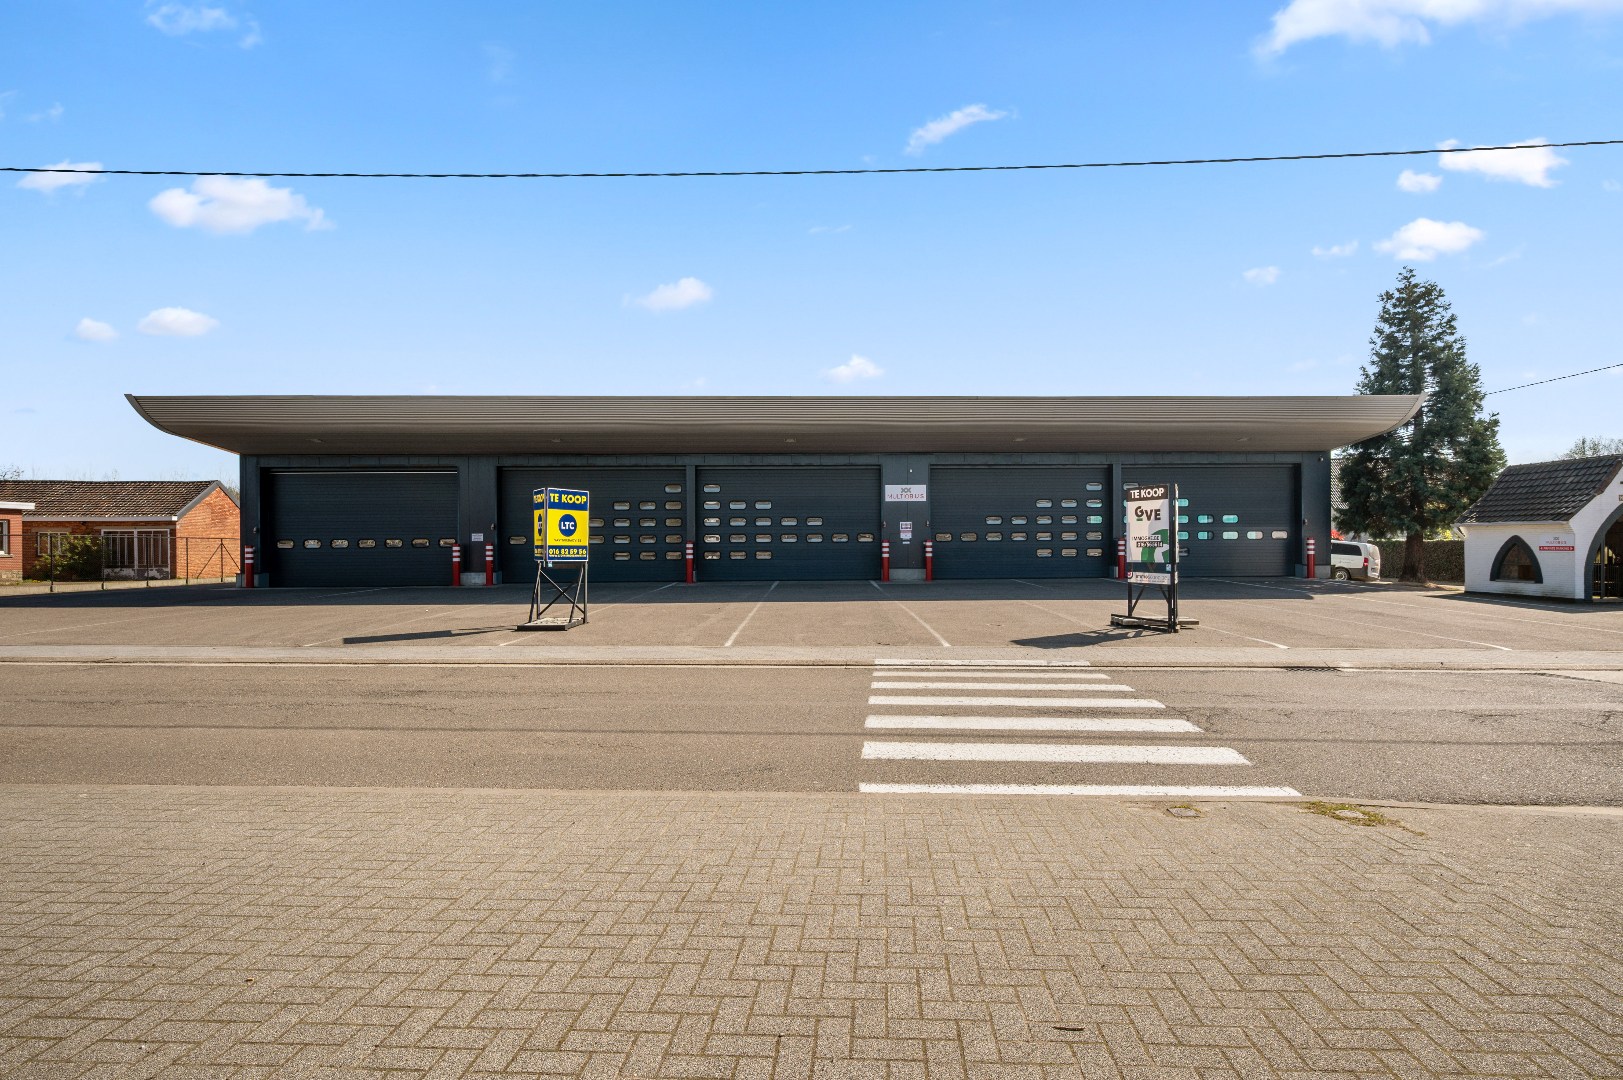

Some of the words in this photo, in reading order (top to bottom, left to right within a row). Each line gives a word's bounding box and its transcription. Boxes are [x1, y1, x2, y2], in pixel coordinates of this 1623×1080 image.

[550, 493, 560, 502] TE
[562, 494, 586, 504] KOOP
[1130, 489, 1140, 499] TE
[1140, 487, 1165, 498] KOOP
[1134, 505, 1161, 521] GVE
[560, 522, 574, 530] LTC
